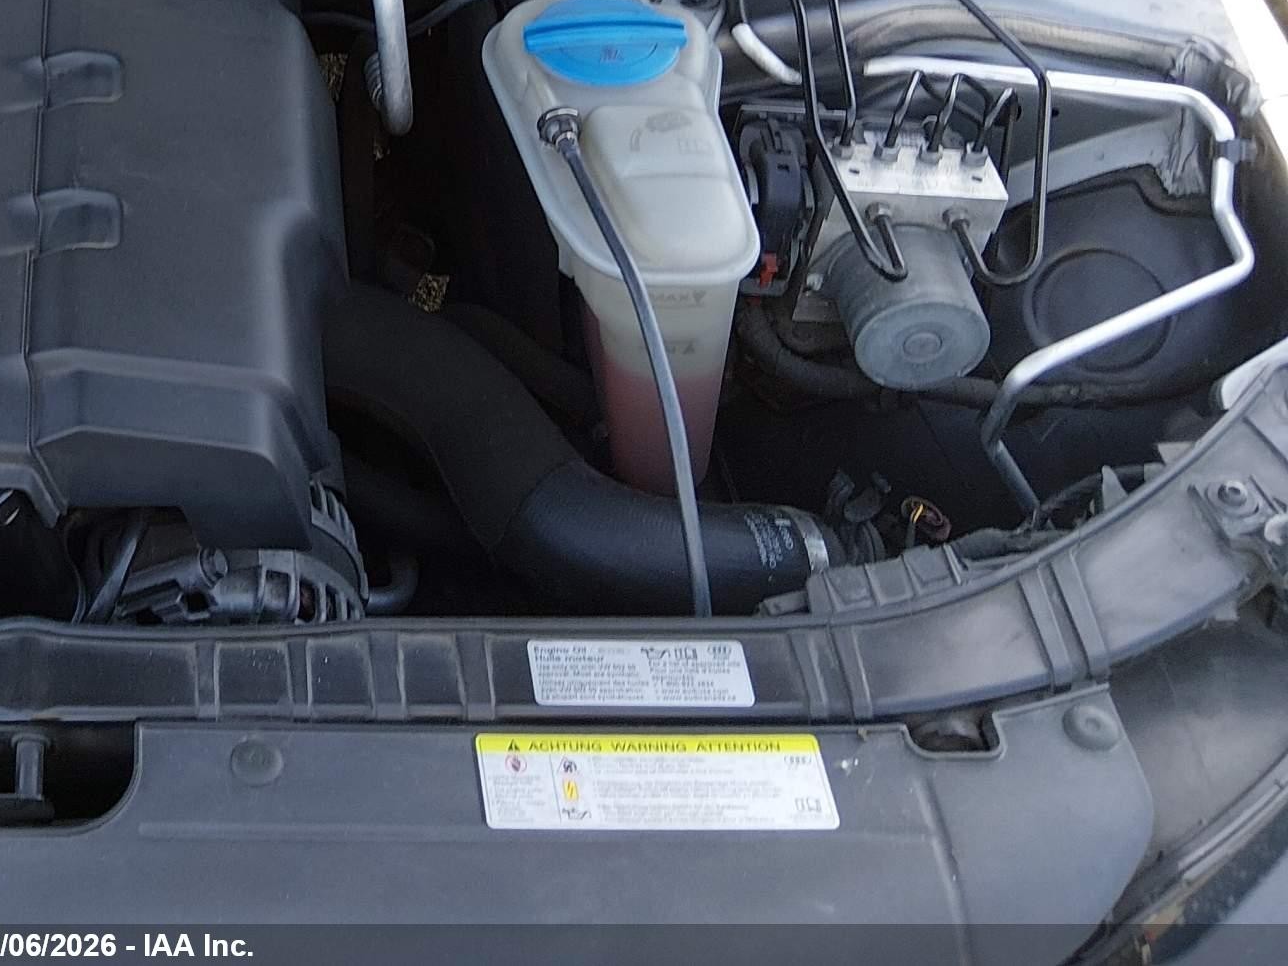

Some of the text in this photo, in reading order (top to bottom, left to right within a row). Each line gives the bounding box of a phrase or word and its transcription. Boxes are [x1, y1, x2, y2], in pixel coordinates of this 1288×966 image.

[534, 645, 569, 657] Engine
[573, 645, 587, 654] Oil
[535, 654, 604, 663] Huile moteur
[528, 740, 781, 752] ACHTUNG WARNING ATTENTION
